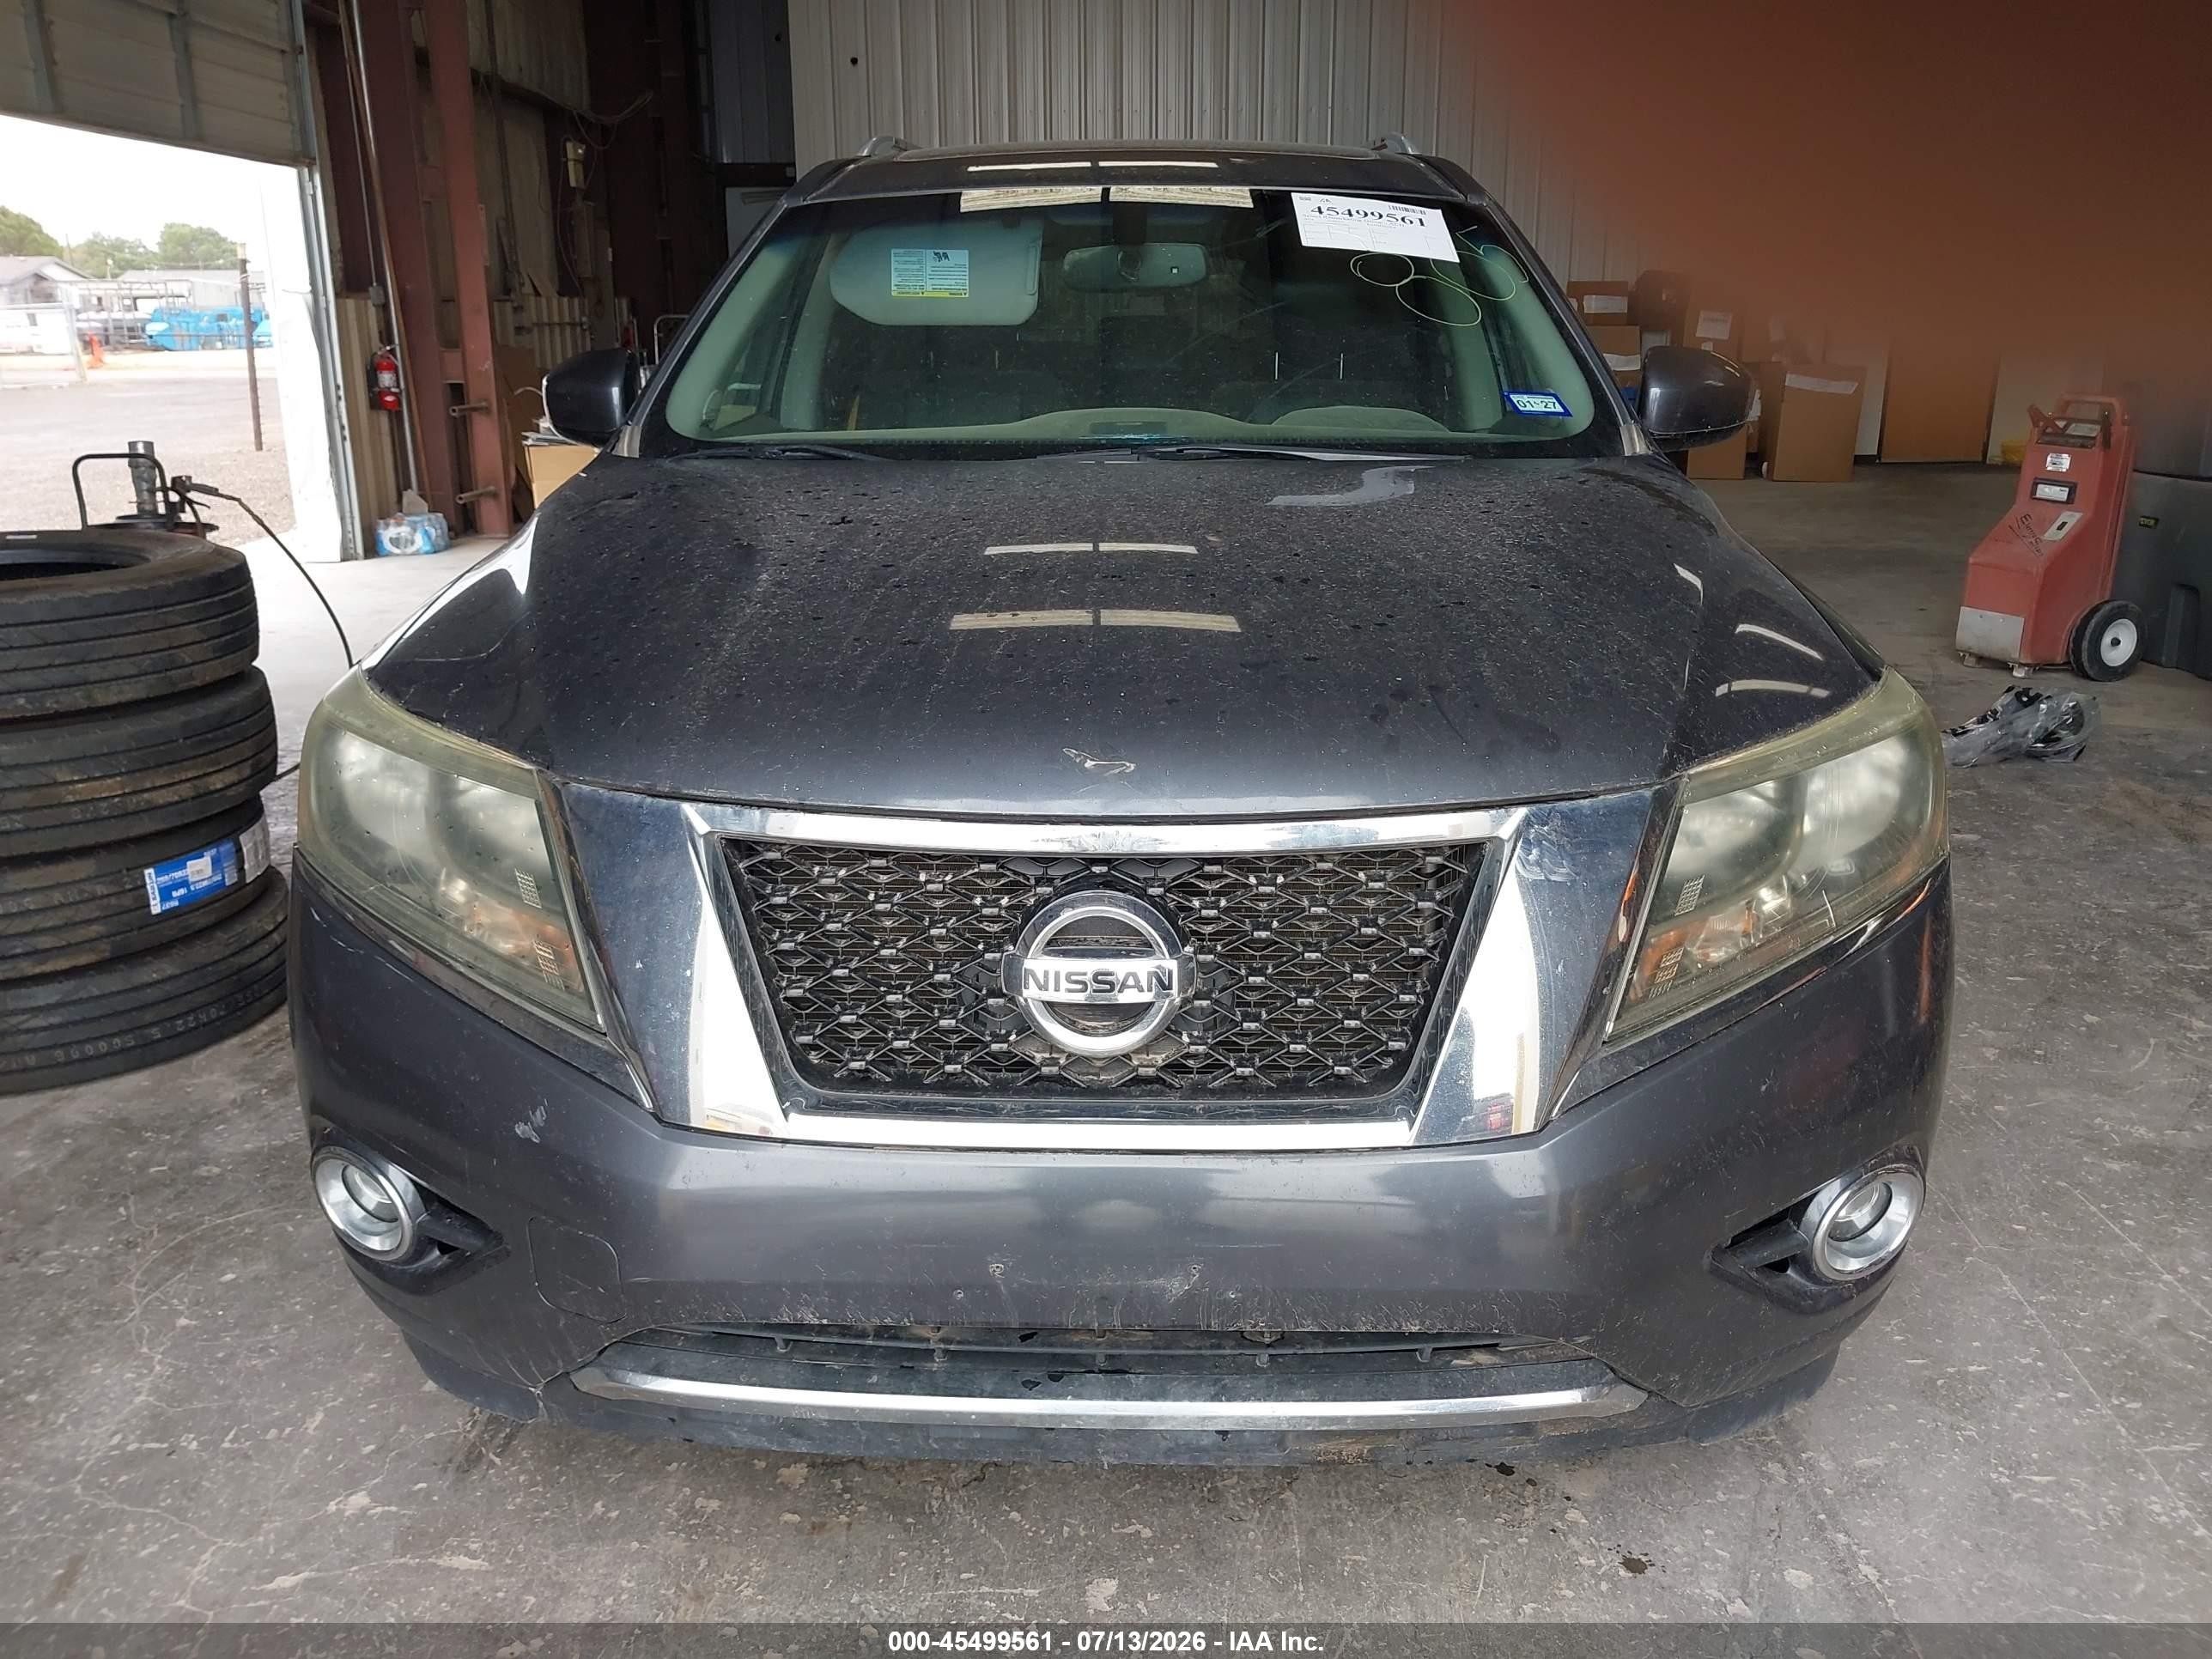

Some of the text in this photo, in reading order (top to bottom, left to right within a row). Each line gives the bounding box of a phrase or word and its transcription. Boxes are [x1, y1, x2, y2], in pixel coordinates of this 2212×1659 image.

[1310, 205, 1426, 228] 45499561
[1516, 399, 1558, 410] 01 27
[1024, 967, 1173, 994] NISSAN
